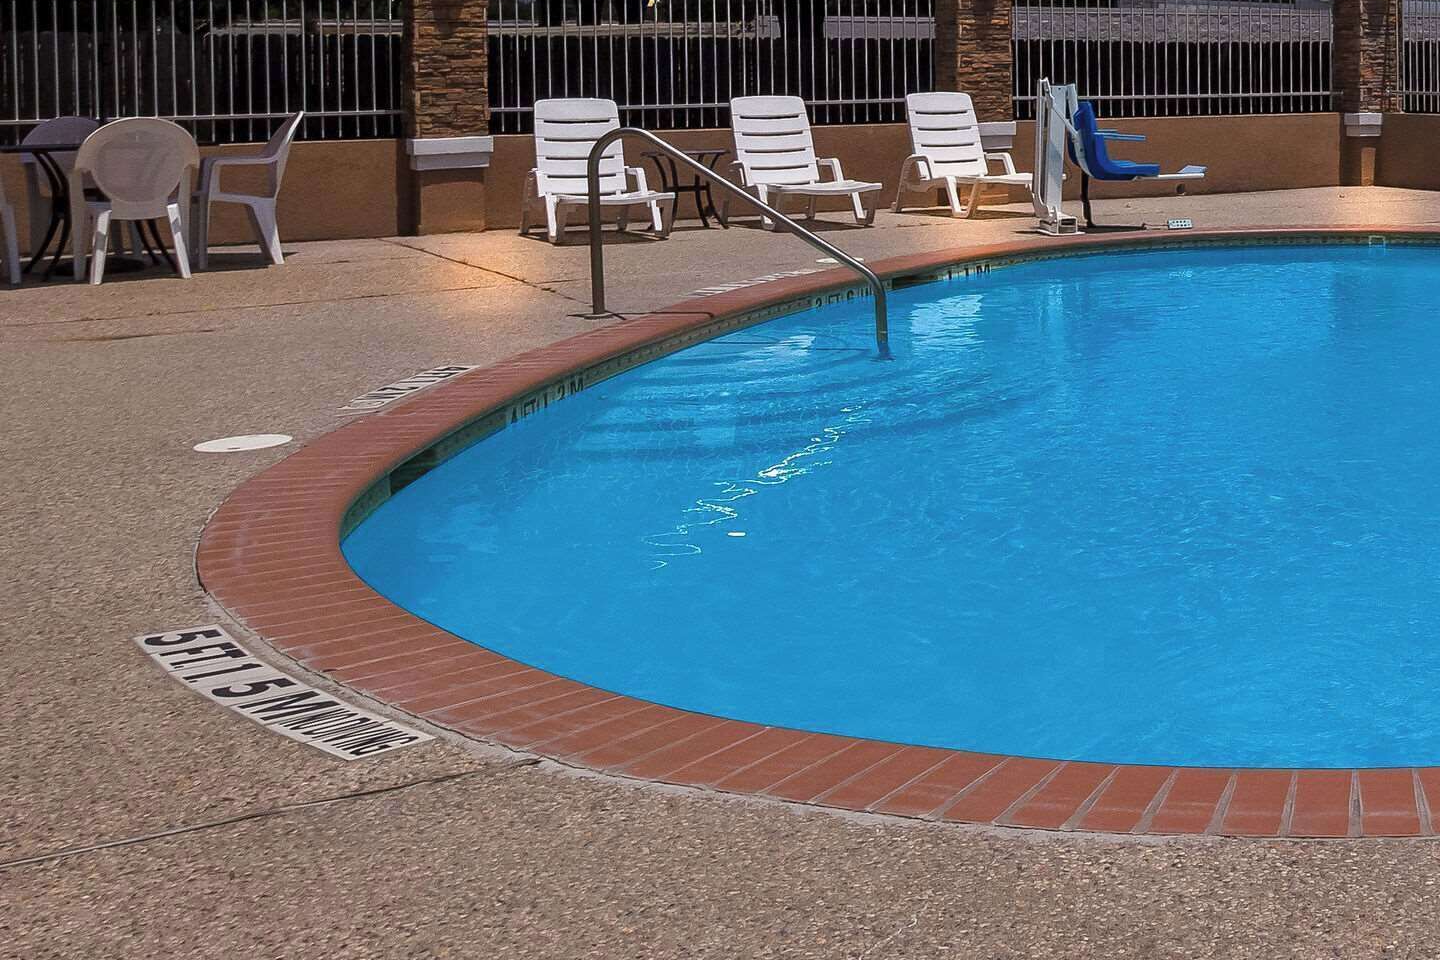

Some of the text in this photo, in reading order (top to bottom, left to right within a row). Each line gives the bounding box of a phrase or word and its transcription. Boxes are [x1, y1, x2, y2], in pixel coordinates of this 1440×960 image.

[570, 377, 584, 396] M
[144, 629, 222, 646] 5
[237, 690, 341, 721] M
[279, 707, 359, 730] NO
[301, 717, 420, 755] DIVING
